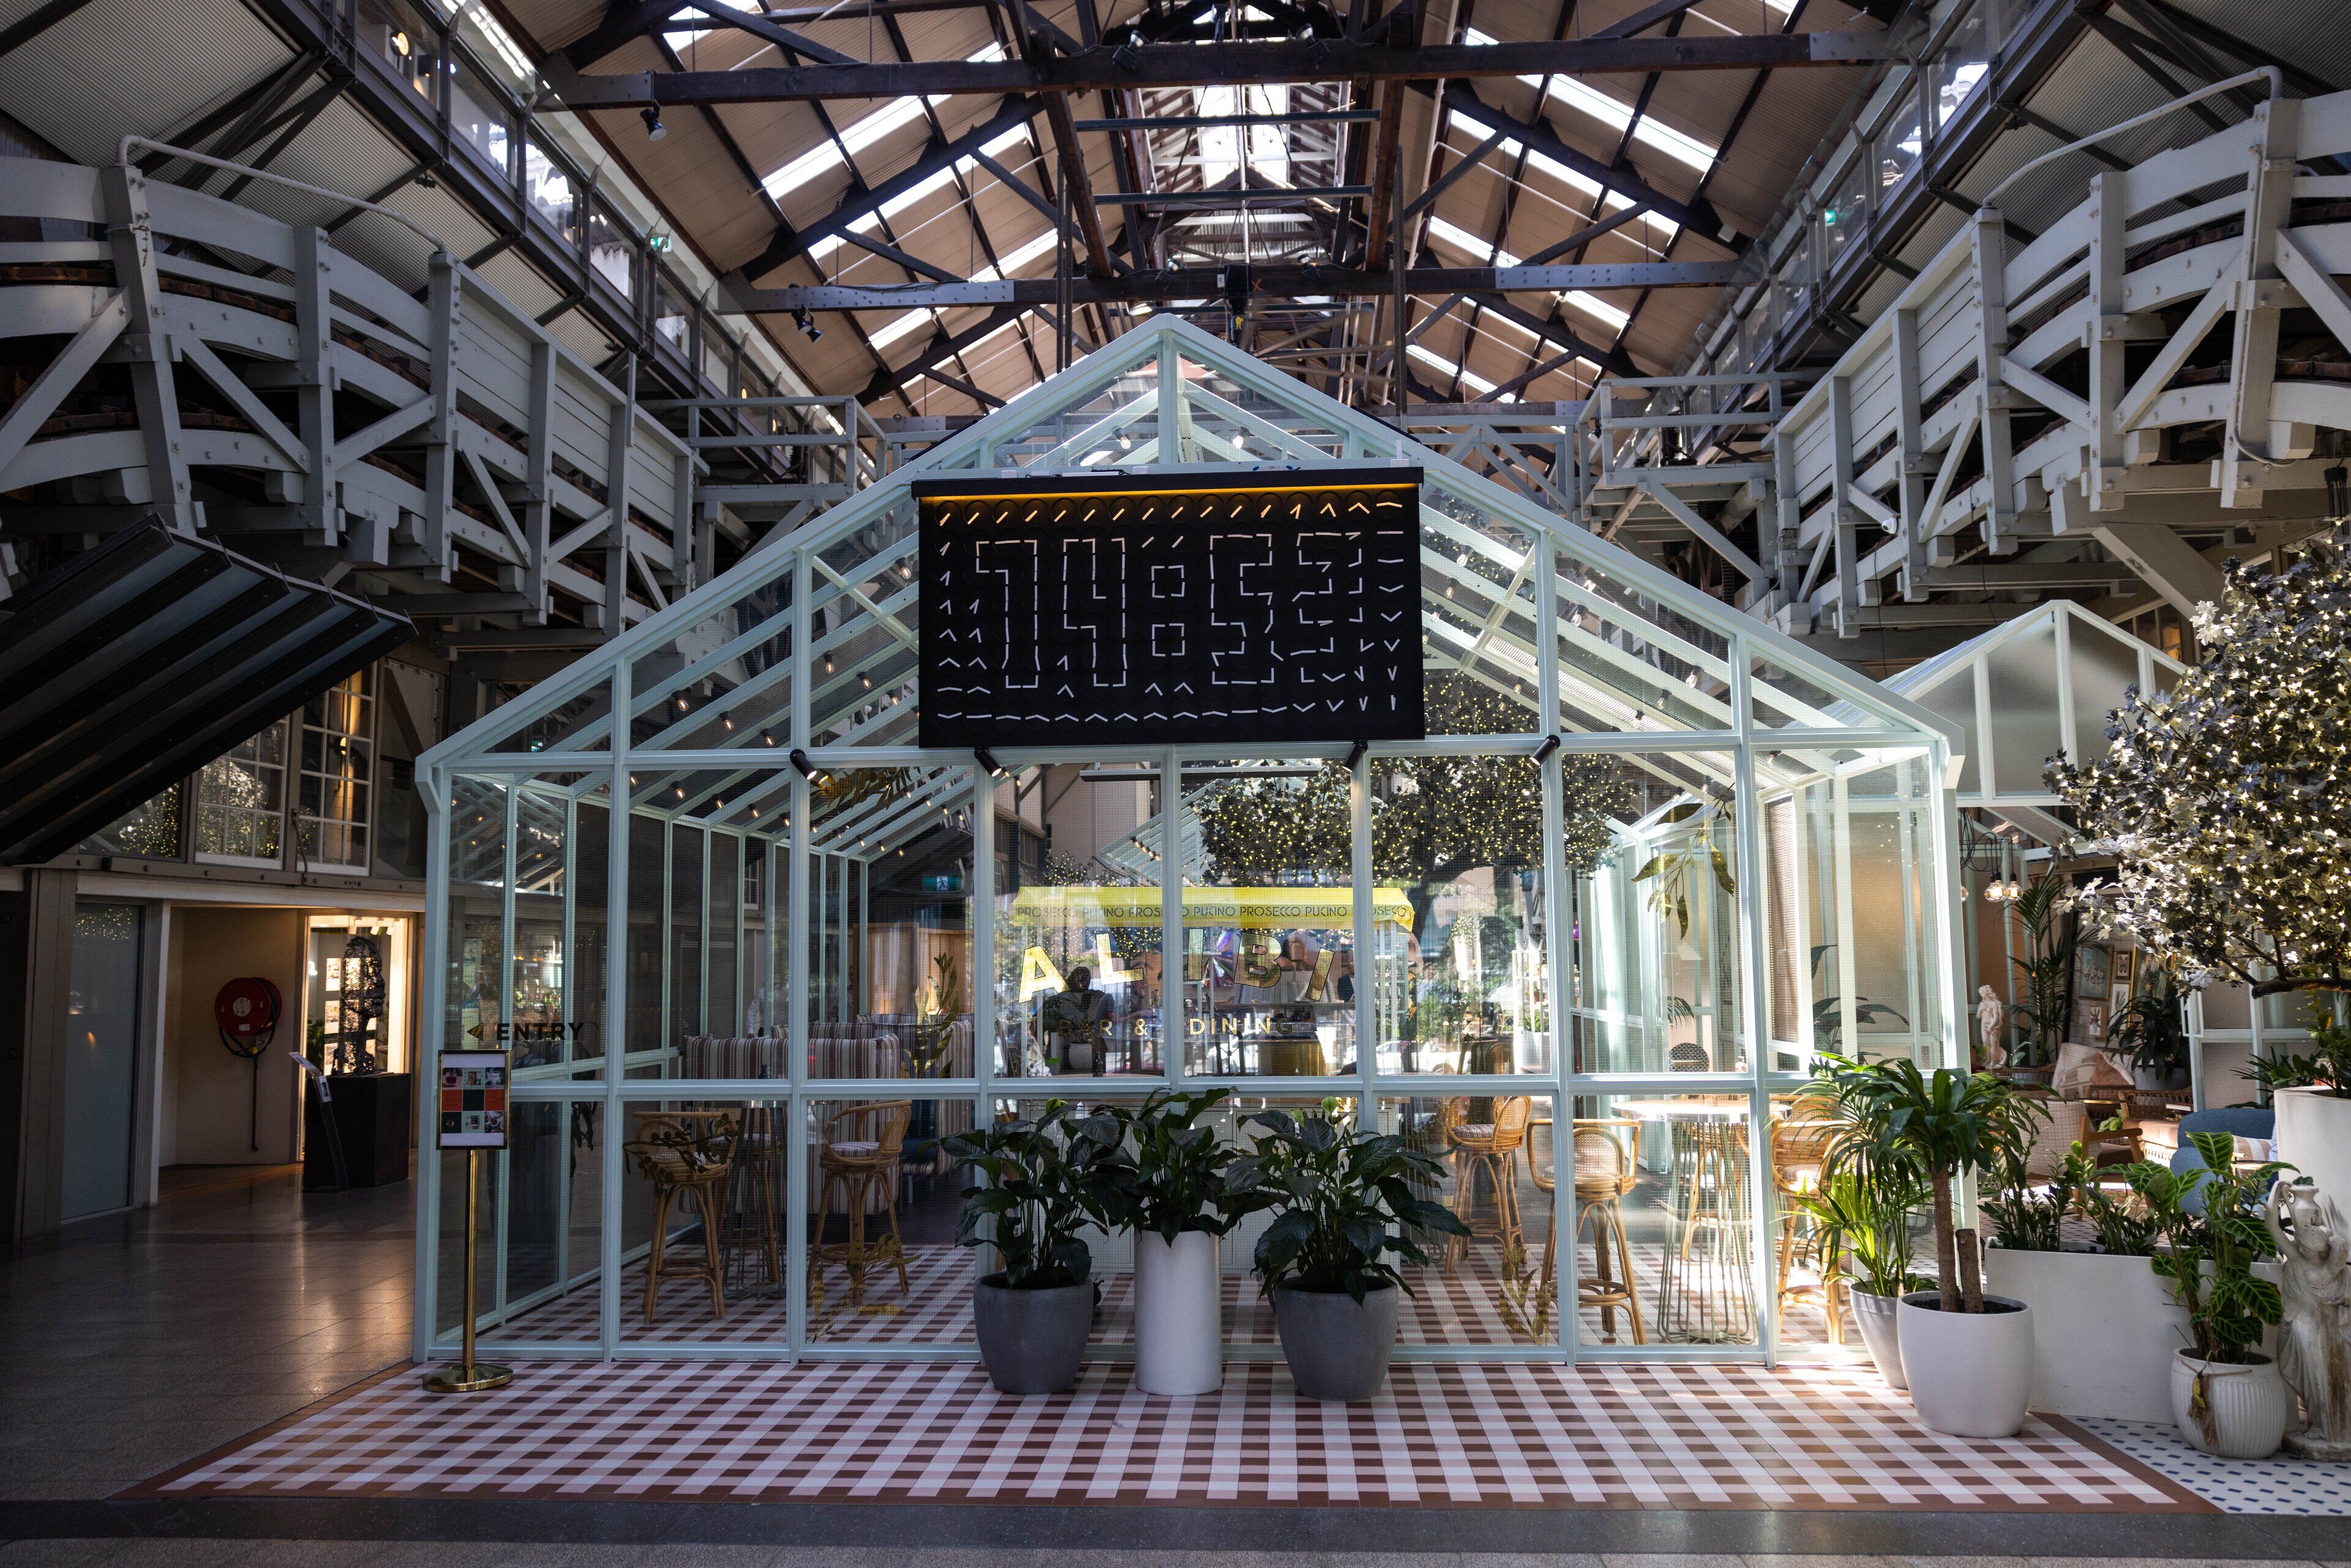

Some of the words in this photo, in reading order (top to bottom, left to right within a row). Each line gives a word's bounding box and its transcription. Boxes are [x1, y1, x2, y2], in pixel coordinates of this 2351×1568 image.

[1018, 907, 1078, 918] PROSECCO
[1082, 907, 1125, 918] PUCINO
[1193, 906, 1235, 917] PUCINO
[1240, 906, 1301, 917] PROSECCO
[1305, 906, 1348, 917] PUCINO
[1019, 928, 1335, 1003] ALIBI
[497, 1022, 583, 1040] ENTRY
[1058, 1018, 1113, 1037] BAR
[1133, 1018, 1149, 1037] &
[1189, 1017, 1293, 1036] DINING
